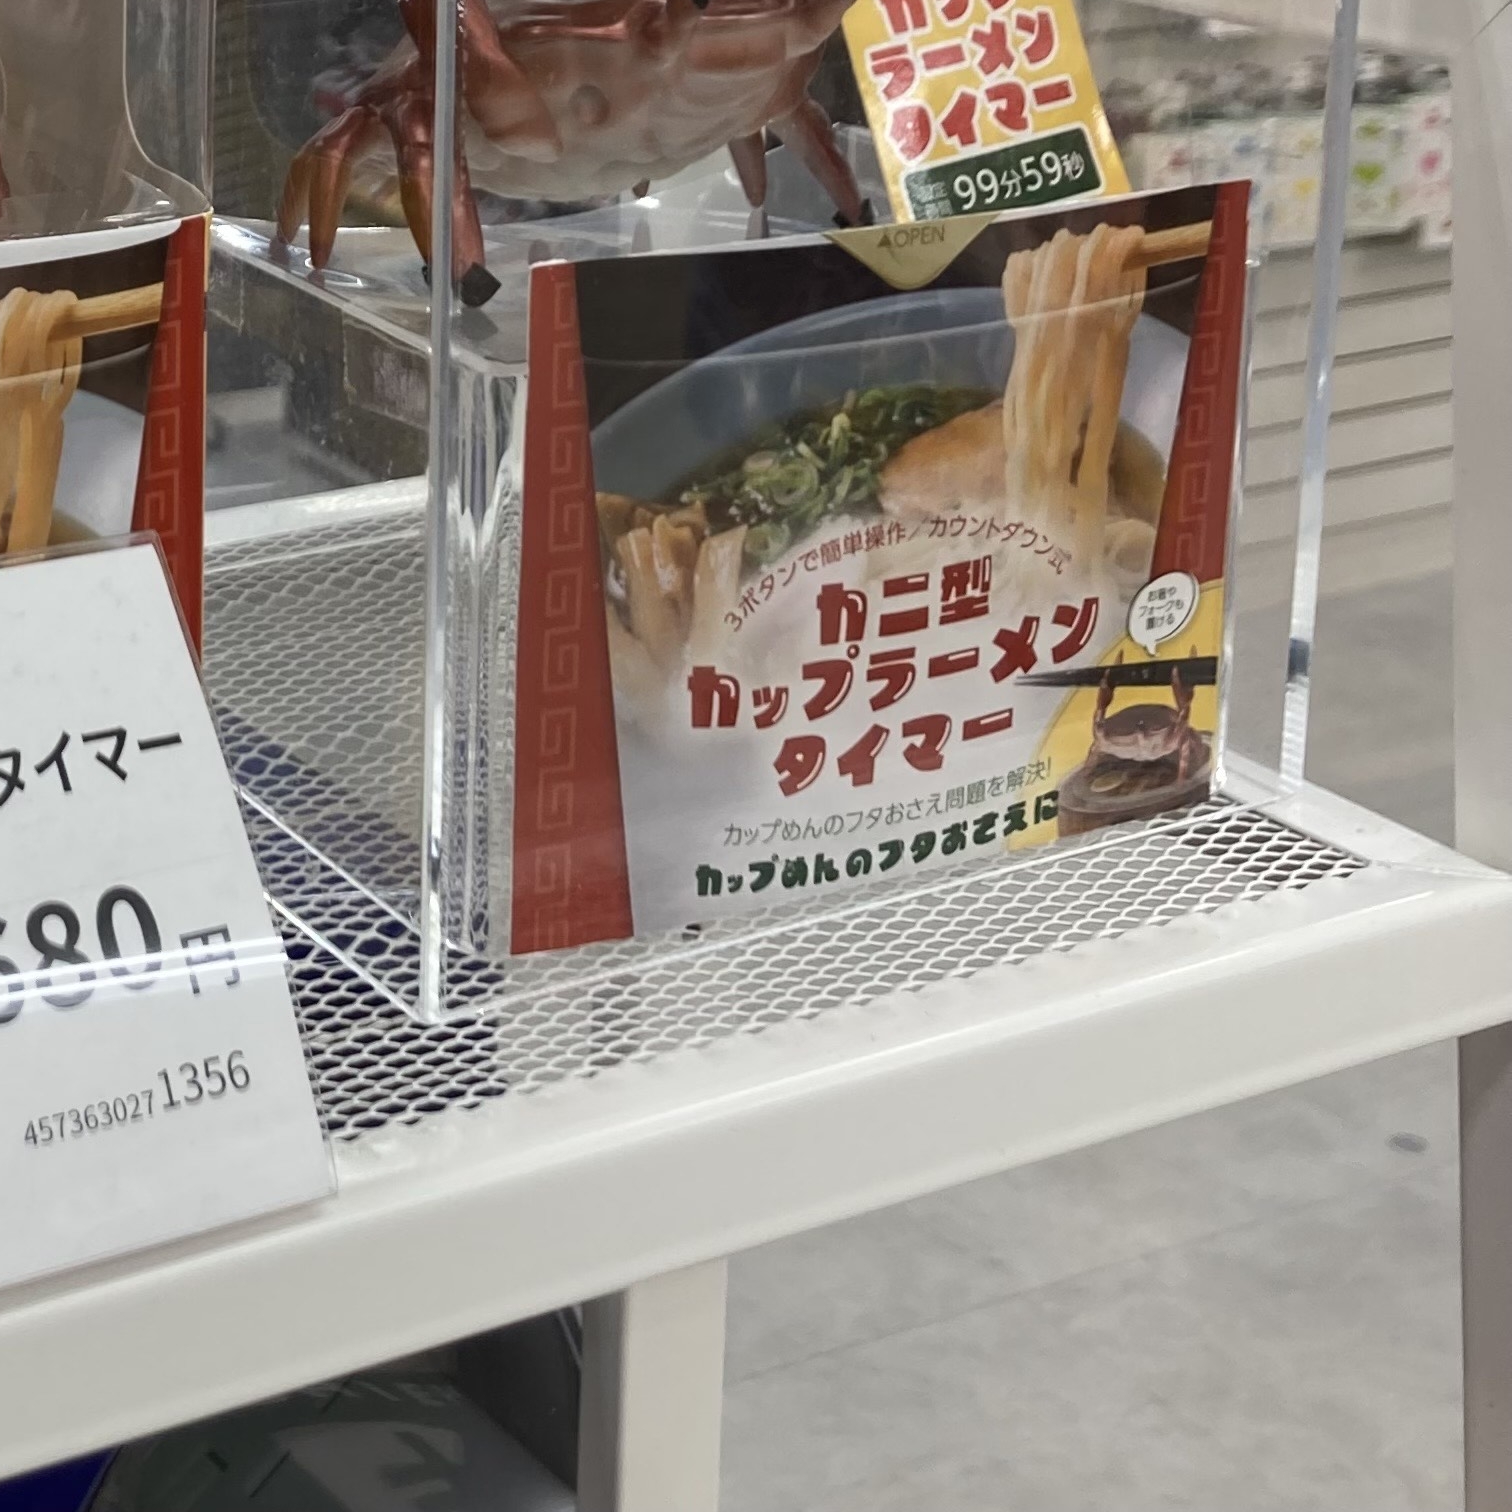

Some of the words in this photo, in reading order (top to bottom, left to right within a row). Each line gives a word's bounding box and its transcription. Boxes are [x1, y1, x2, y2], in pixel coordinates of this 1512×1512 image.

[869, 11, 1056, 101] ラーメン
[889, 79, 1073, 161] タイマー
[953, 149, 1086, 211] 99分59秒
[894, 224, 945, 249] OPEN
[816, 554, 992, 646] カニ型
[688, 596, 1100, 729] カップラーメン
[773, 708, 1014, 797] タイマー
[694, 789, 1060, 897] カップめんのフタおさえに
[723, 756, 1052, 847] カップめんのフタおさえ問題を解決!
